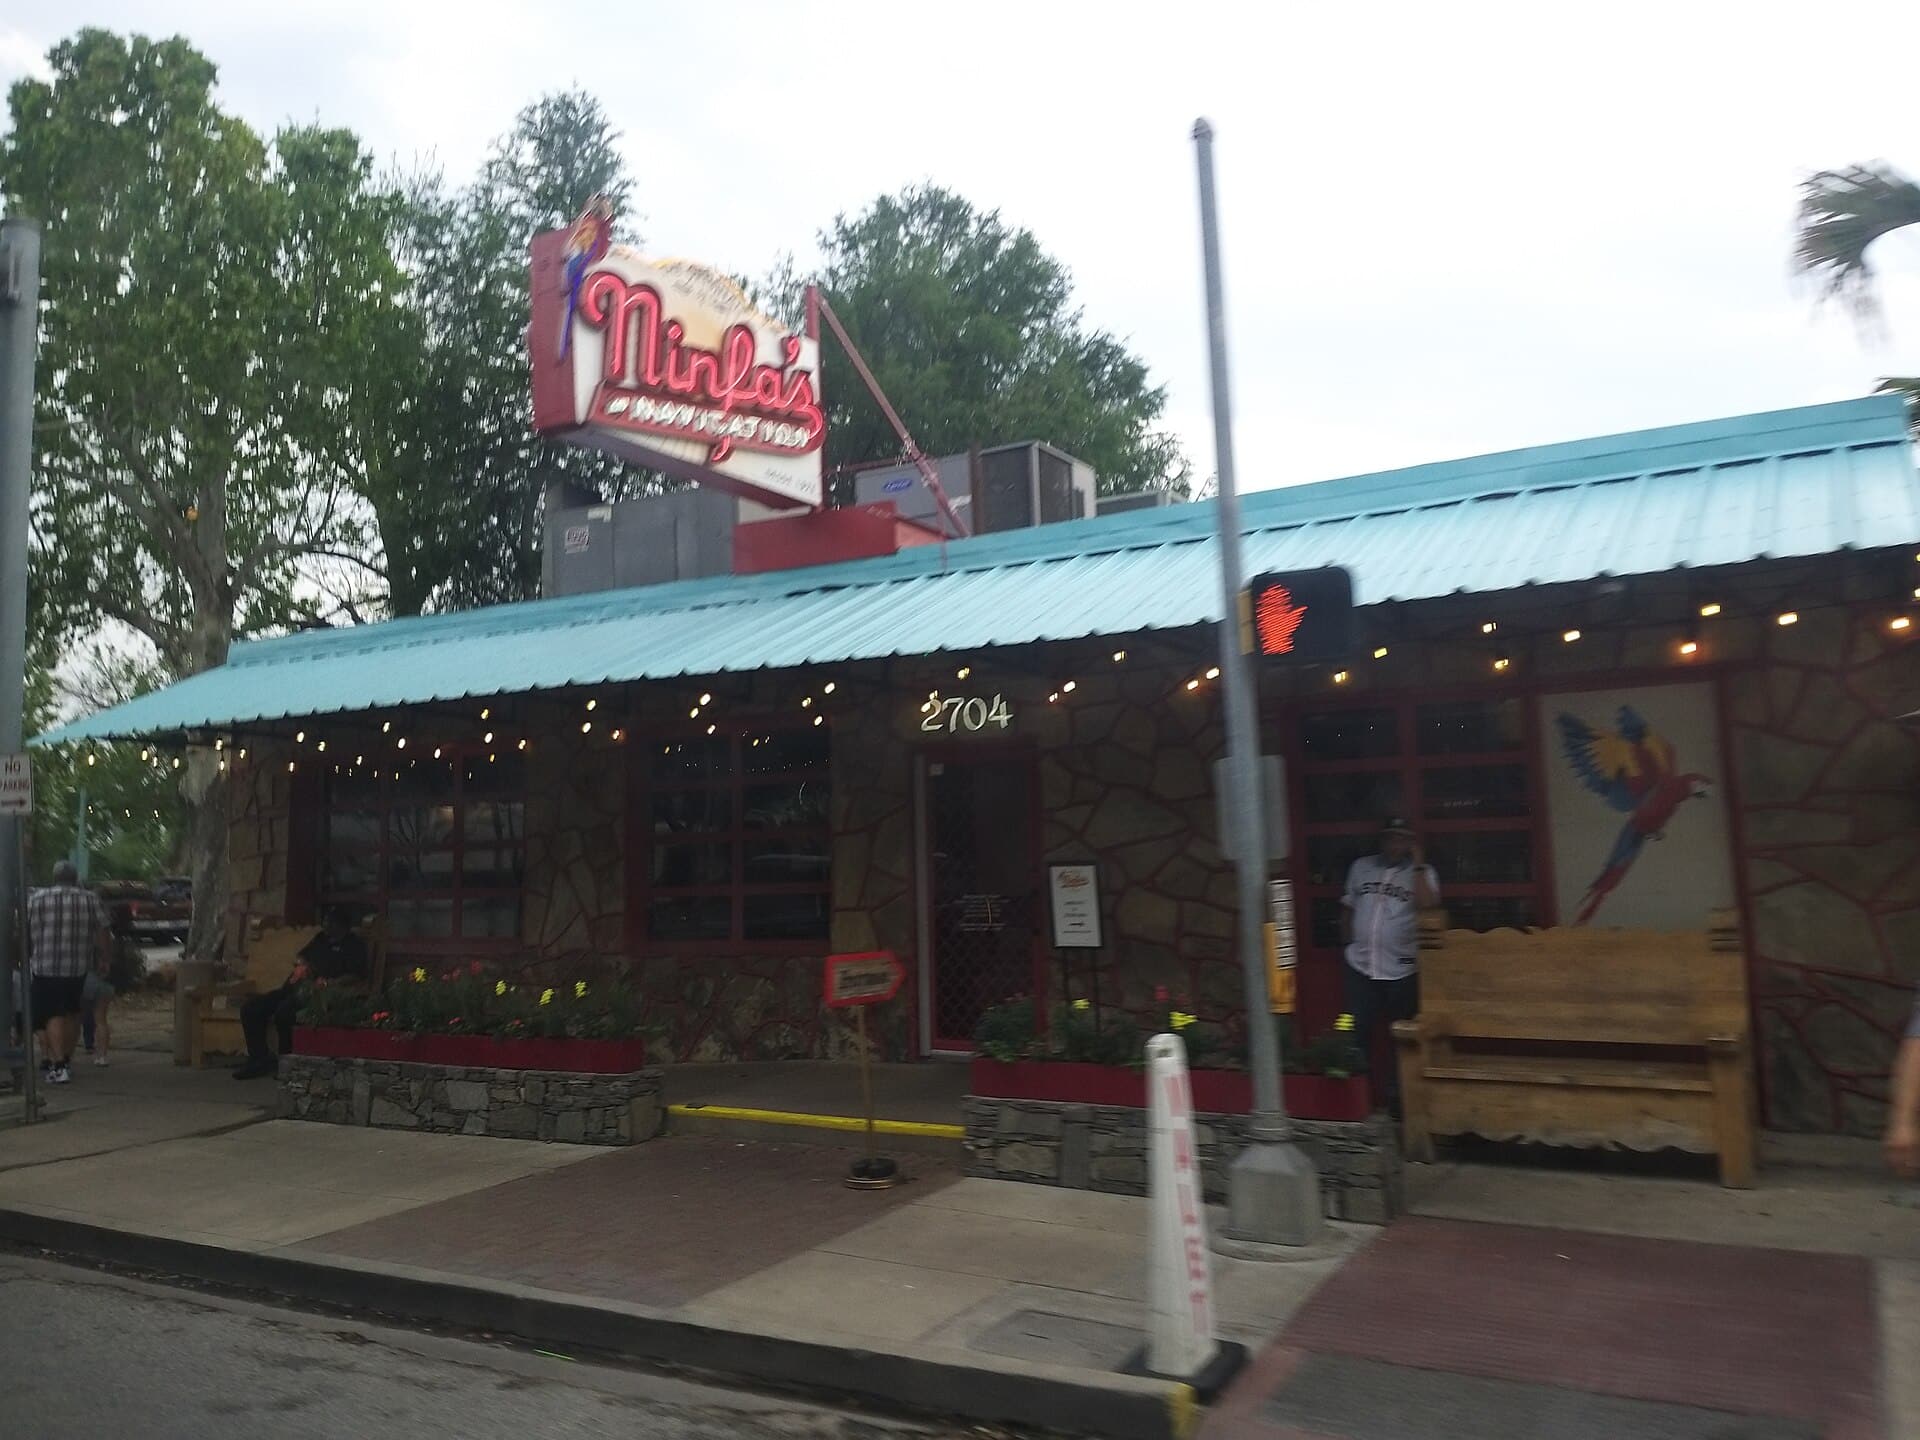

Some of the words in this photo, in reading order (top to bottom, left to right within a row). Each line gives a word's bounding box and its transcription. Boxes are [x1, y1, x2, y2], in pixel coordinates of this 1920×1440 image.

[581, 272, 822, 462] Ninfa's
[920, 692, 1014, 734] 2704
[5, 761, 21, 775] NO
